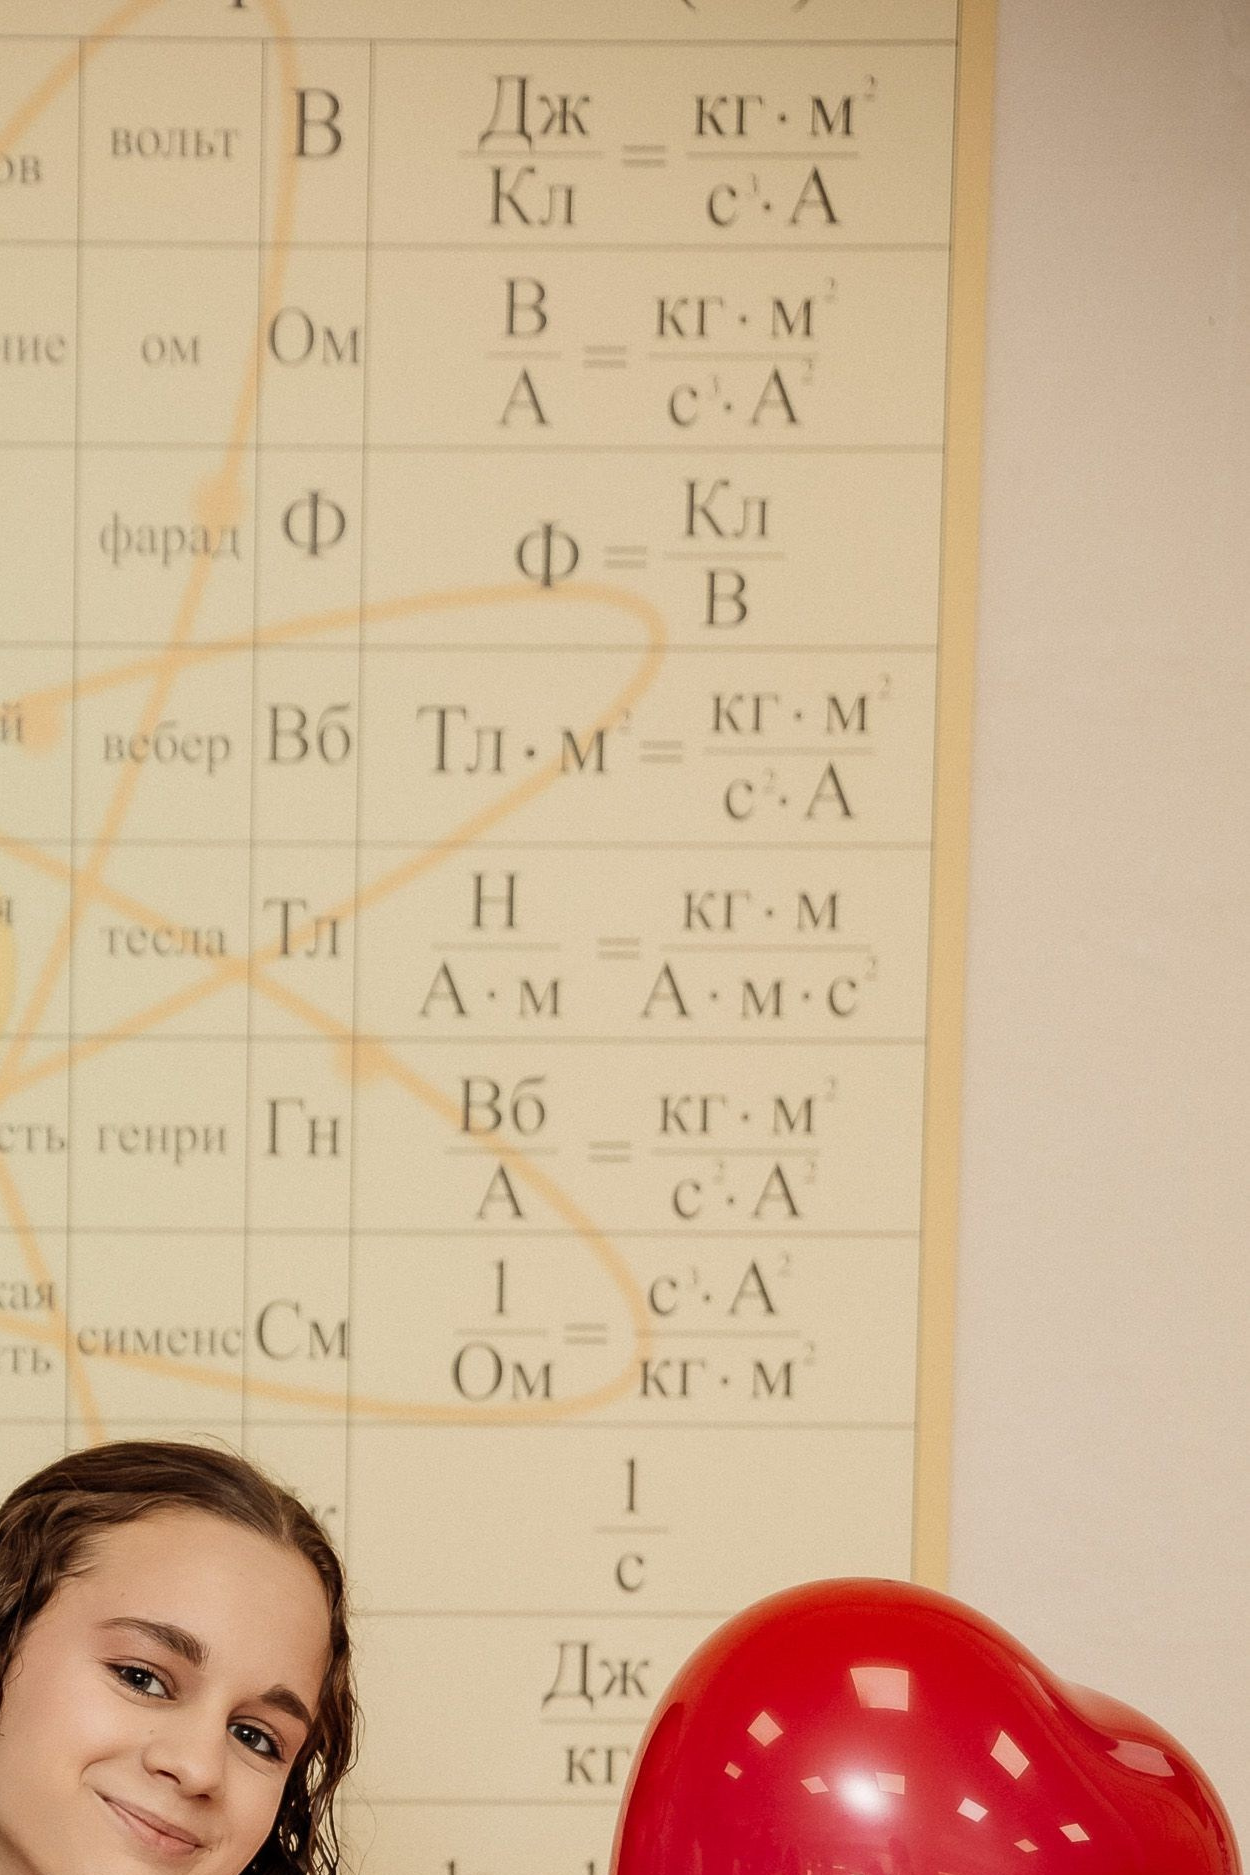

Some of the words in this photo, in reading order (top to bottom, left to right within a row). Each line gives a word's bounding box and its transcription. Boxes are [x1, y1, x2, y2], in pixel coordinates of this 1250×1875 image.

[110, 123, 238, 159] вольт
[293, 88, 342, 158] В
[477, 74, 590, 154] Дж
[489, 166, 576, 226] Кл
[268, 306, 361, 366] Ом
[504, 276, 547, 338] В
[141, 332, 201, 366] ом
[499, 366, 550, 426] А
[98, 511, 242, 568] фарад
[281, 489, 347, 558] Ф
[515, 521, 580, 590] Ф
[684, 478, 770, 538] Кл
[704, 568, 748, 628] В
[102, 718, 231, 776] вебер
[267, 702, 351, 766] Вб
[262, 898, 341, 959] Тл
[471, 871, 518, 930] Н
[101, 921, 227, 957] тесла
[266, 1098, 340, 1158] Гн
[460, 1075, 546, 1136] Вб
[97, 1119, 227, 1164] генри
[476, 1163, 523, 1220] А
[493, 1259, 507, 1315] 1
[76, 1323, 244, 1356] сименс
[254, 1299, 350, 1361] См
[451, 1341, 551, 1401] Ом
[625, 1457, 637, 1513] 1
[542, 1641, 649, 1710] Дж
[564, 1747, 630, 1785] кг
